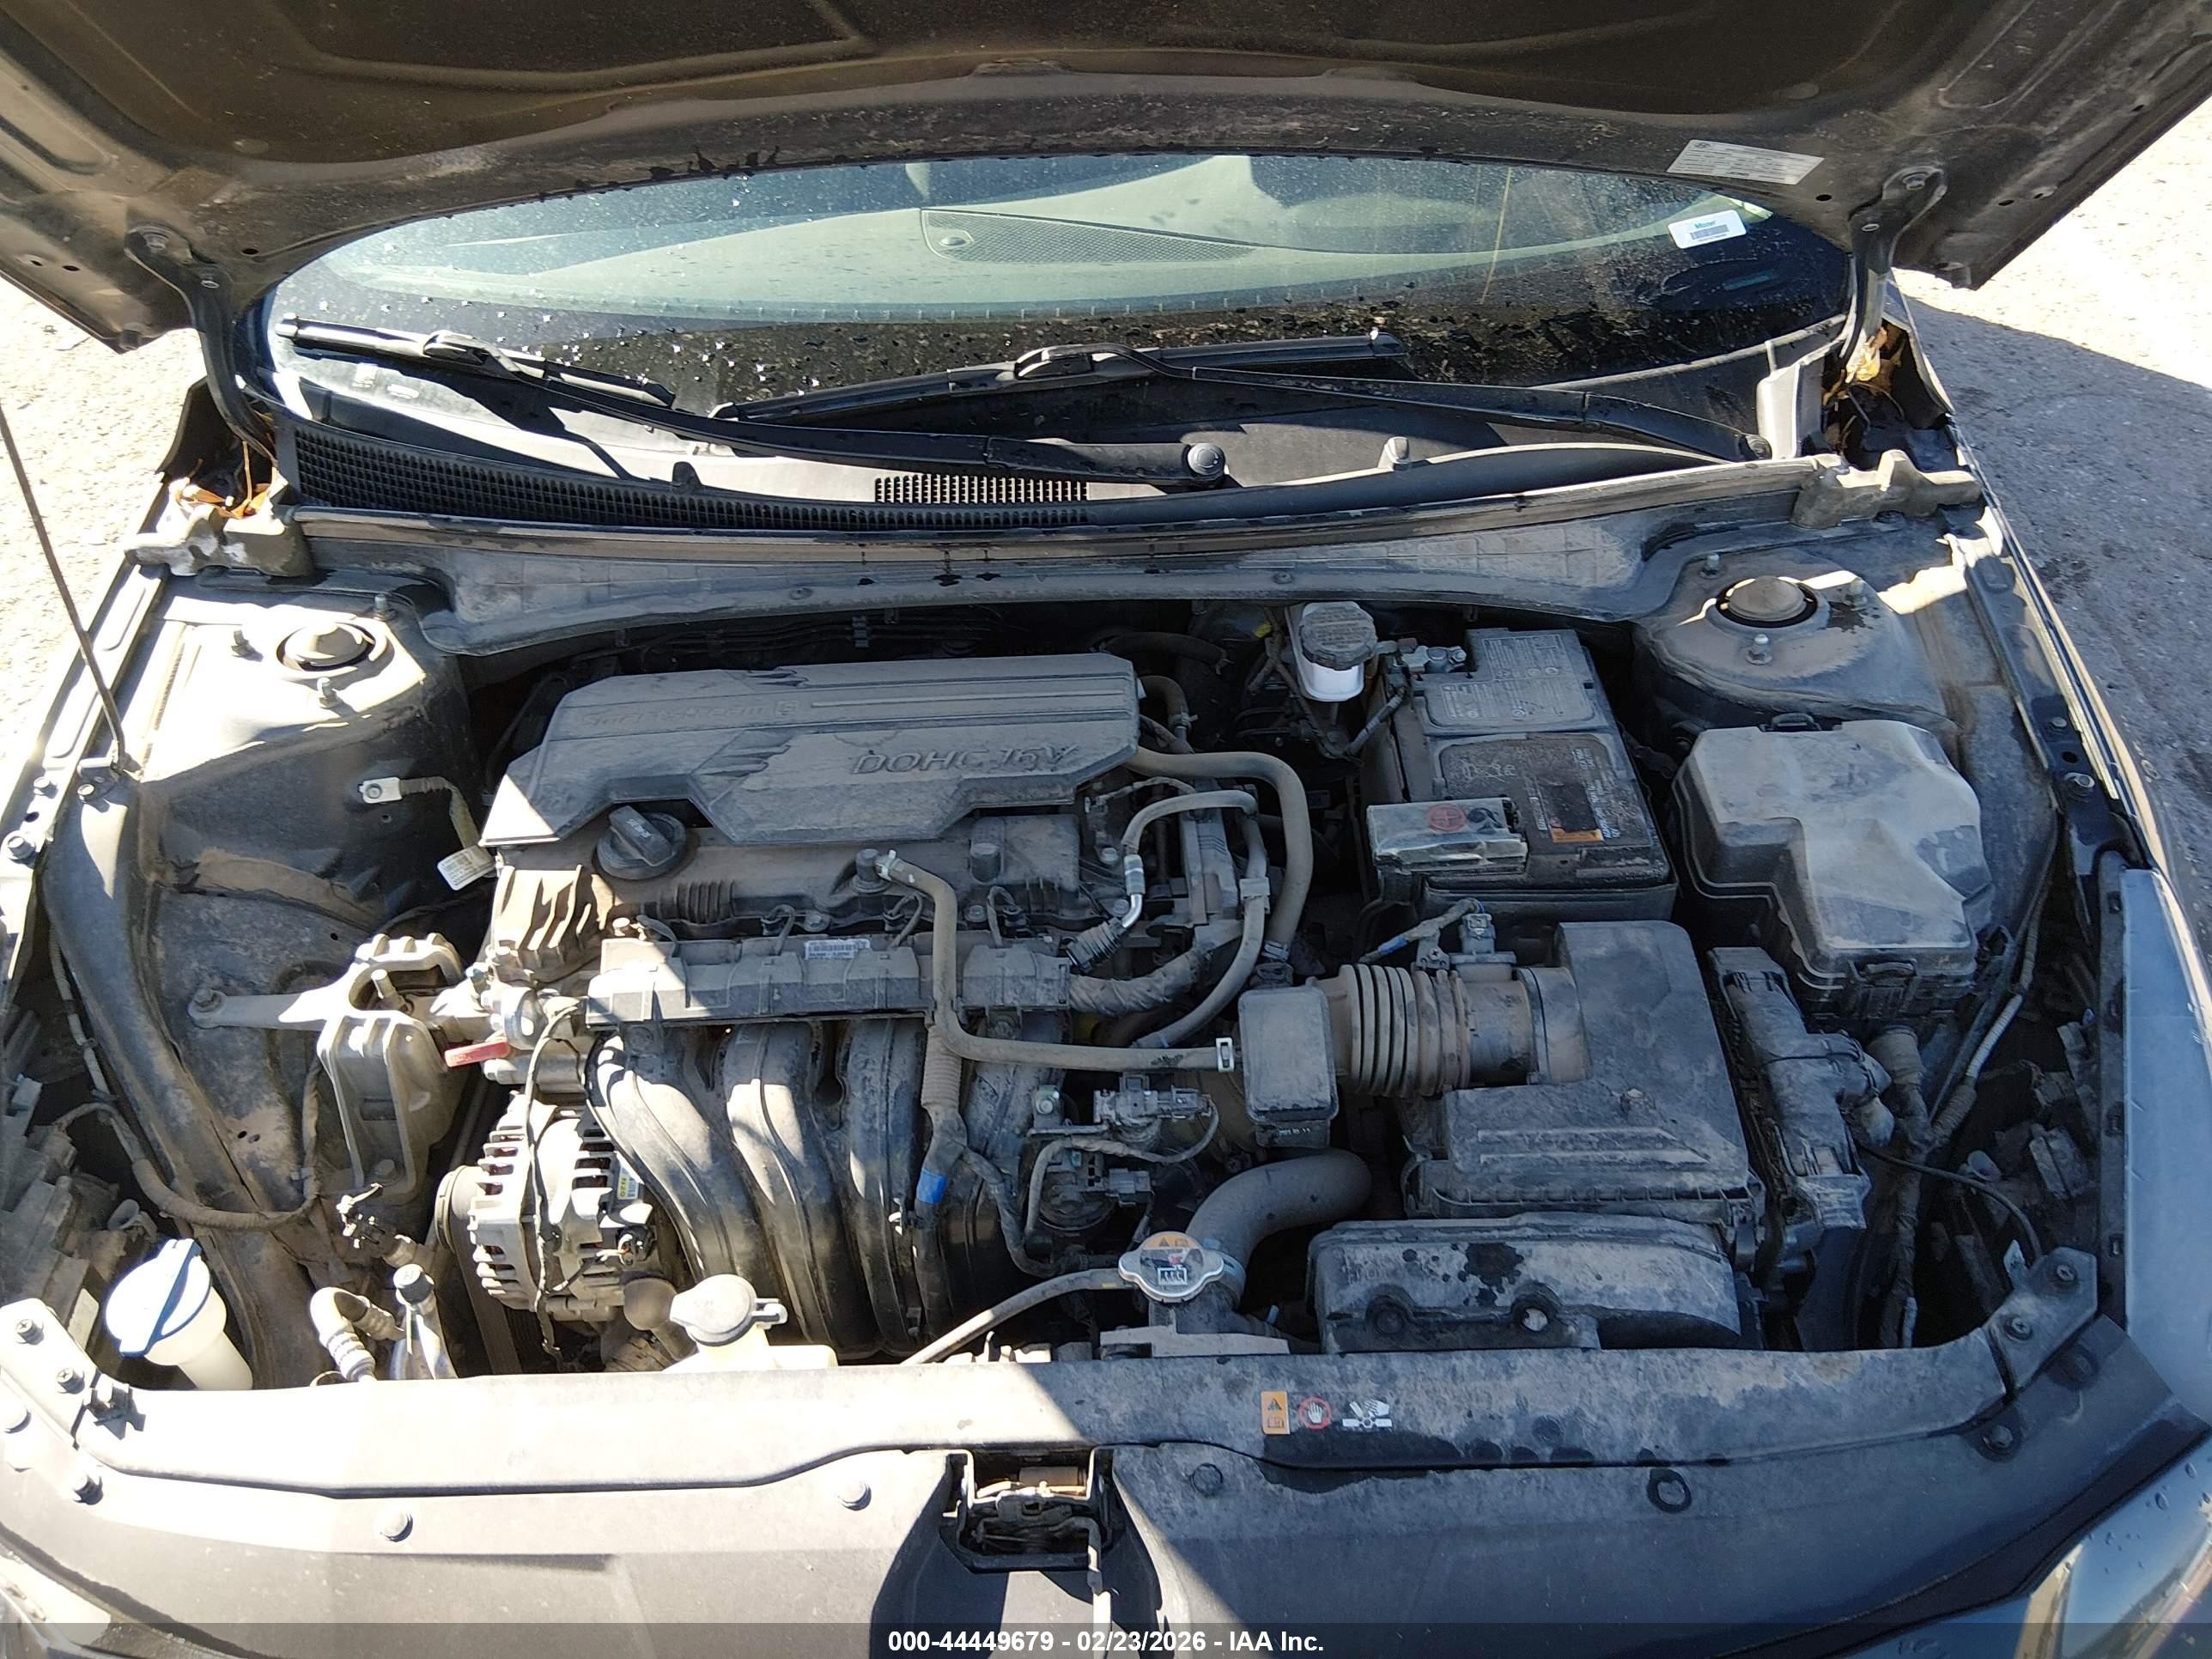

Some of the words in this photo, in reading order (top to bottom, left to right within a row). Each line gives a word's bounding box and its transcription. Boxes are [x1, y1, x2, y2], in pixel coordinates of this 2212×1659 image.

[580, 706, 766, 726] Smartstream
[854, 748, 988, 774] DOHC
[999, 744, 1080, 772] 16V
